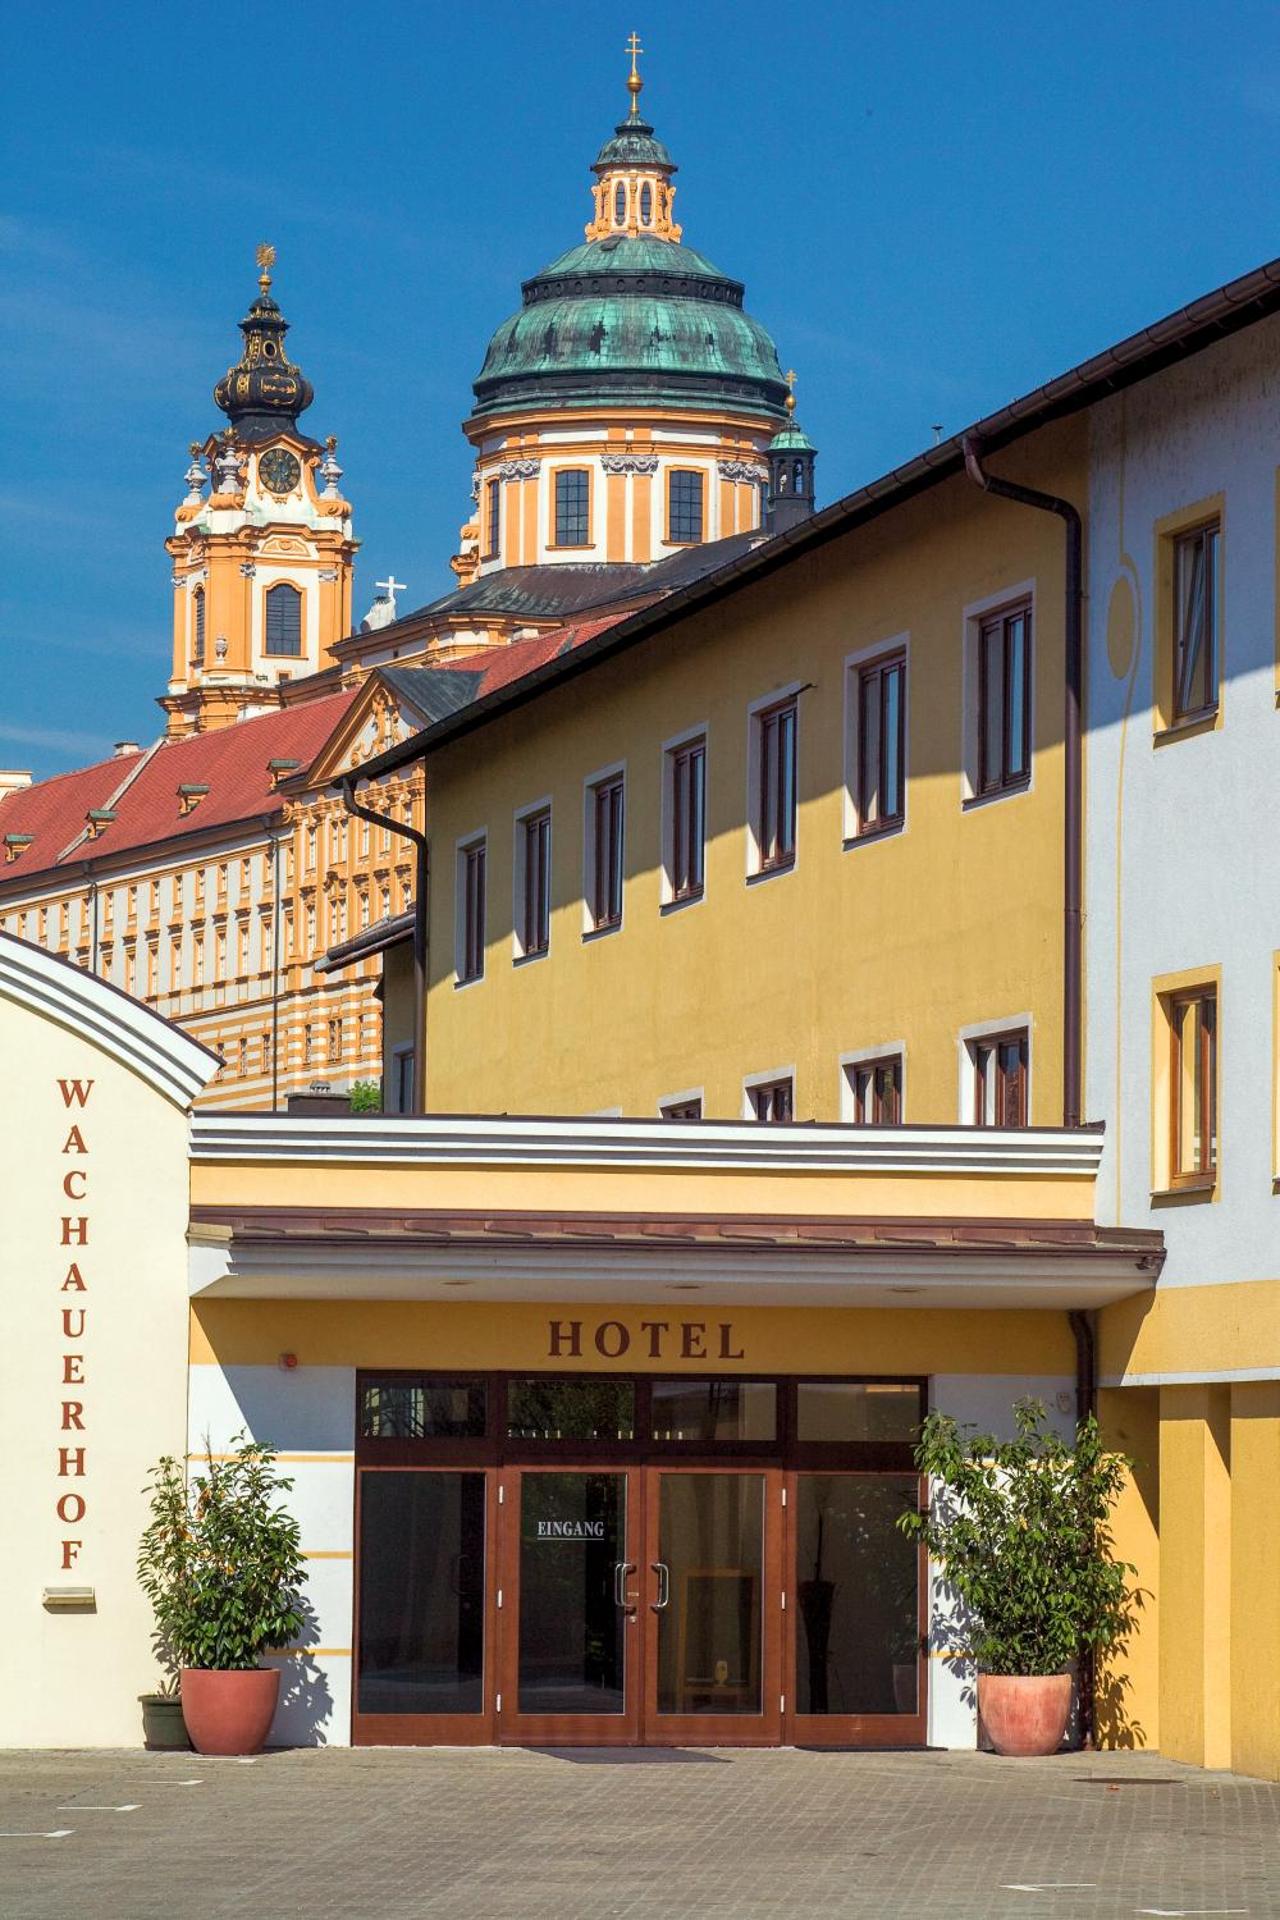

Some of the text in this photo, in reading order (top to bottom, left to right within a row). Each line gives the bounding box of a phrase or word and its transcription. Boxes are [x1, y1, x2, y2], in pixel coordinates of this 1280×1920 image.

[57, 1080, 95, 1569] WACHAUERHOF
[547, 1320, 745, 1359] HOTEL
[537, 1521, 604, 1537] EINGANG
